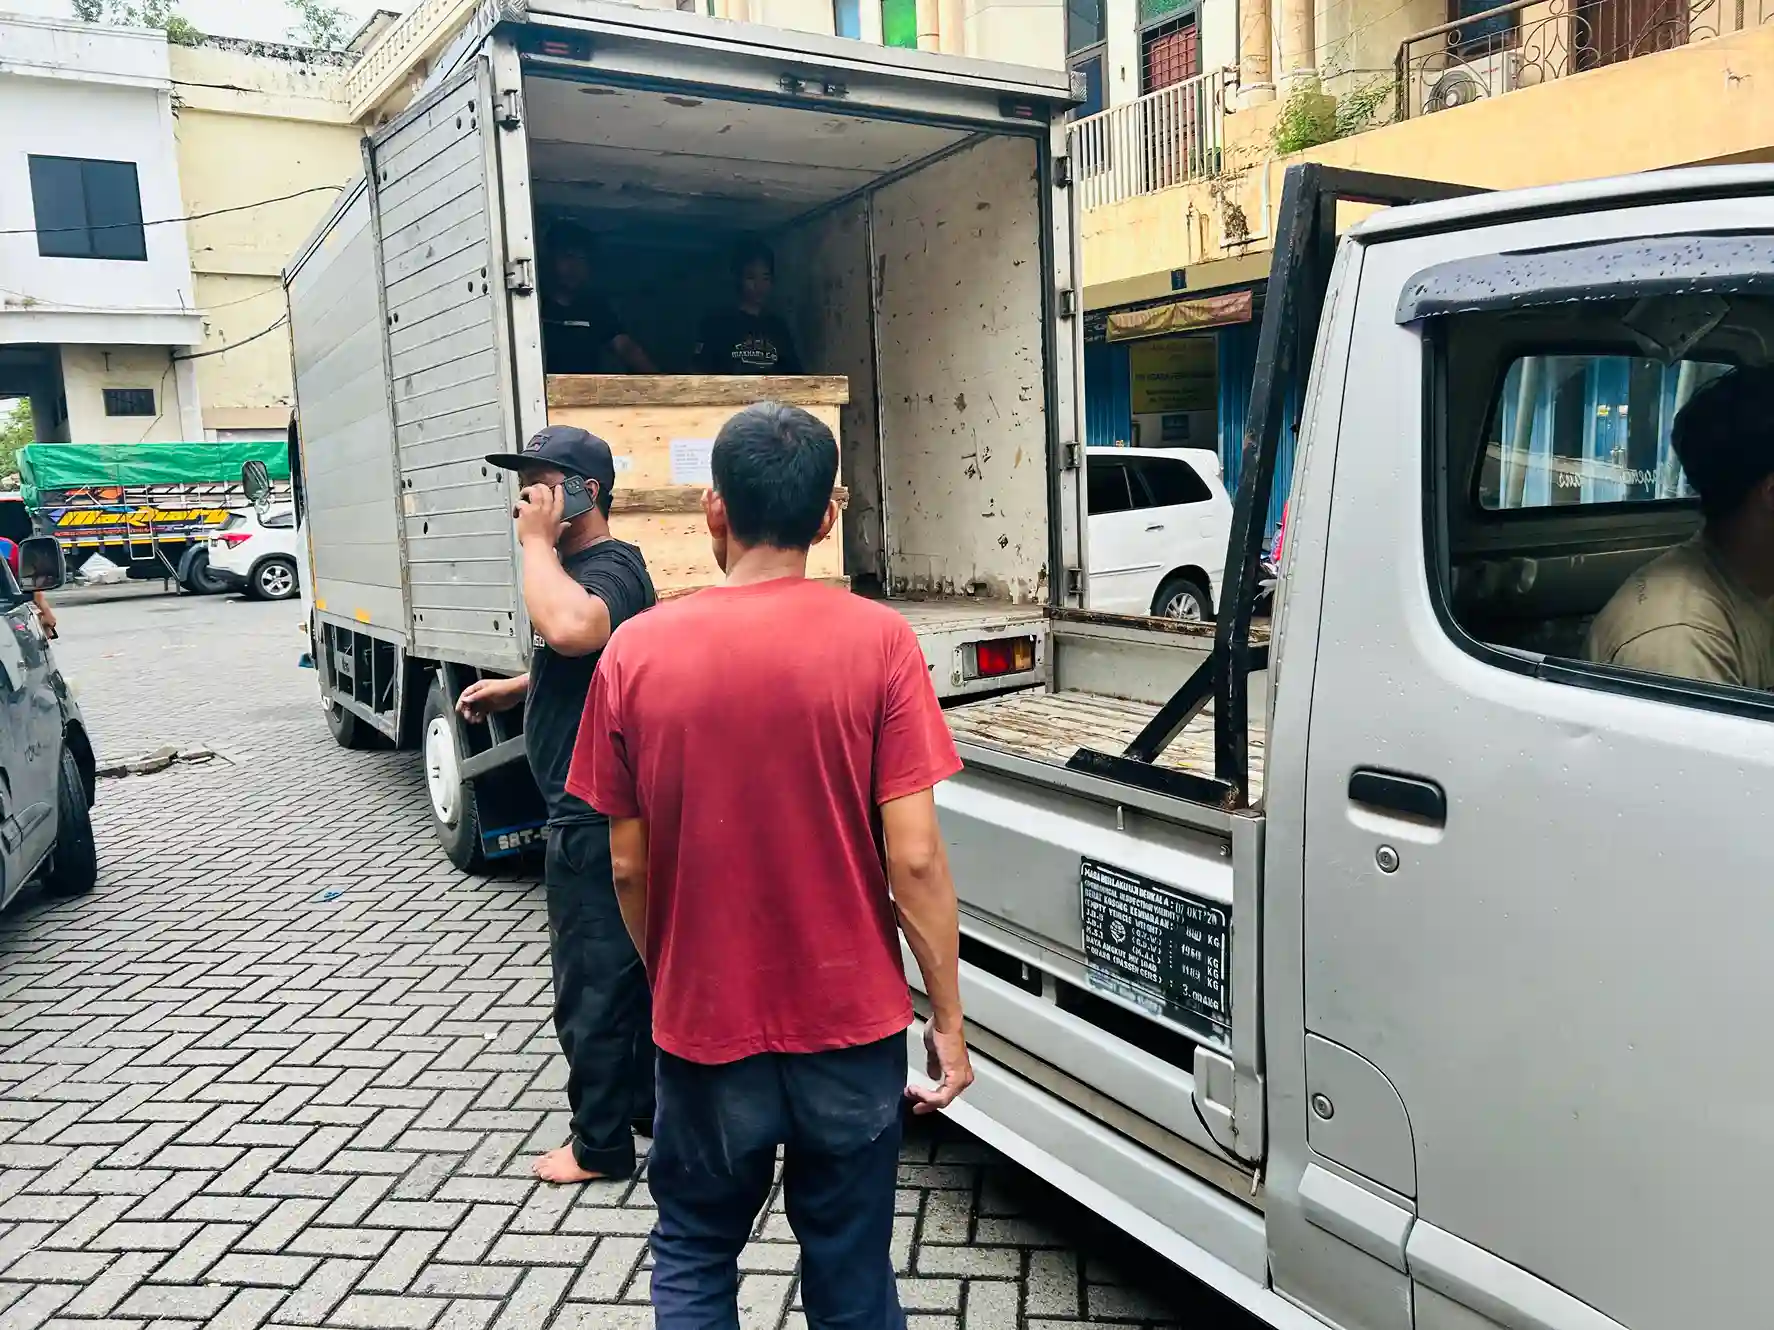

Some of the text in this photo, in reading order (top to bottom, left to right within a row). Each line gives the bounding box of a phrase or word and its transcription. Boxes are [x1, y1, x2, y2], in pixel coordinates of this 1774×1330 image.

[1101, 874, 1127, 891] BERLAKU
[1086, 935, 1100, 947] DAYA
[1208, 934, 1219, 947] KG
[1208, 955, 1218, 968] KG
[1208, 966, 1218, 979] KG
[1208, 977, 1218, 990] KG
